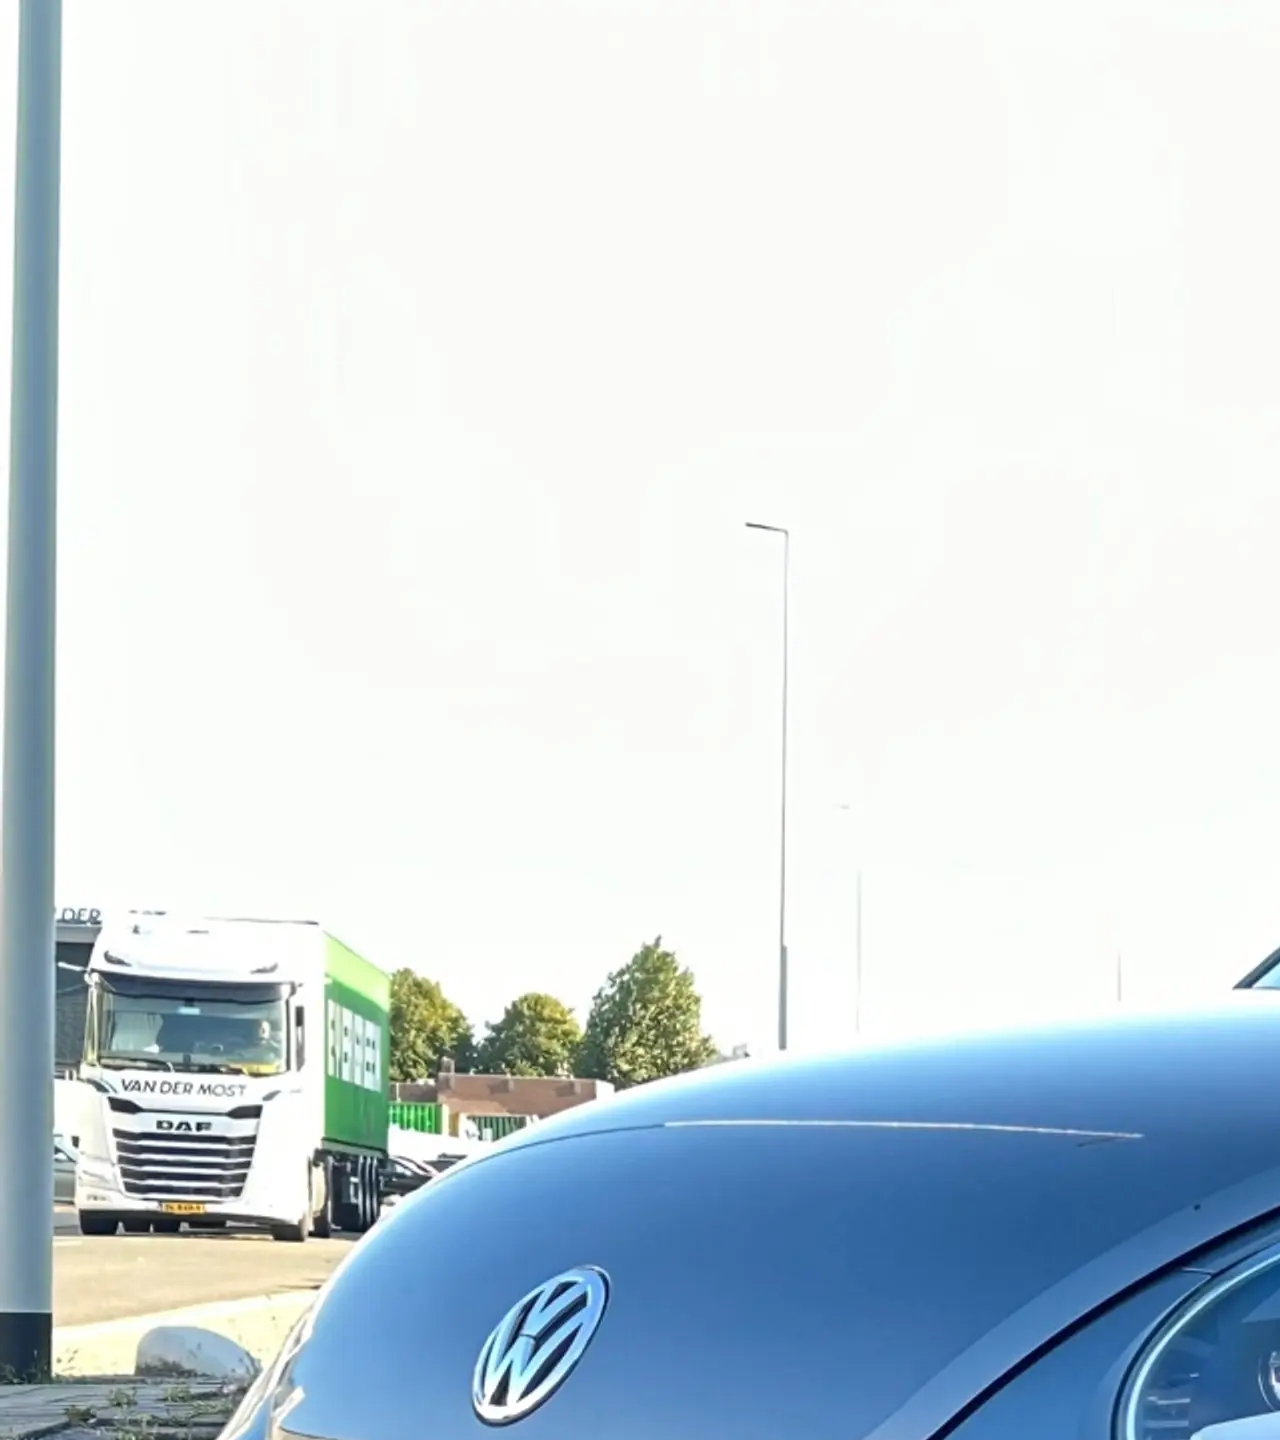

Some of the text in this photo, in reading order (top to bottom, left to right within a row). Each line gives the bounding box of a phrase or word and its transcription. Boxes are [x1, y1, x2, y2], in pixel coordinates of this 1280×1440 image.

[121, 1078, 247, 1097] VAN DER MOST
[156, 1120, 212, 1132] DAF
